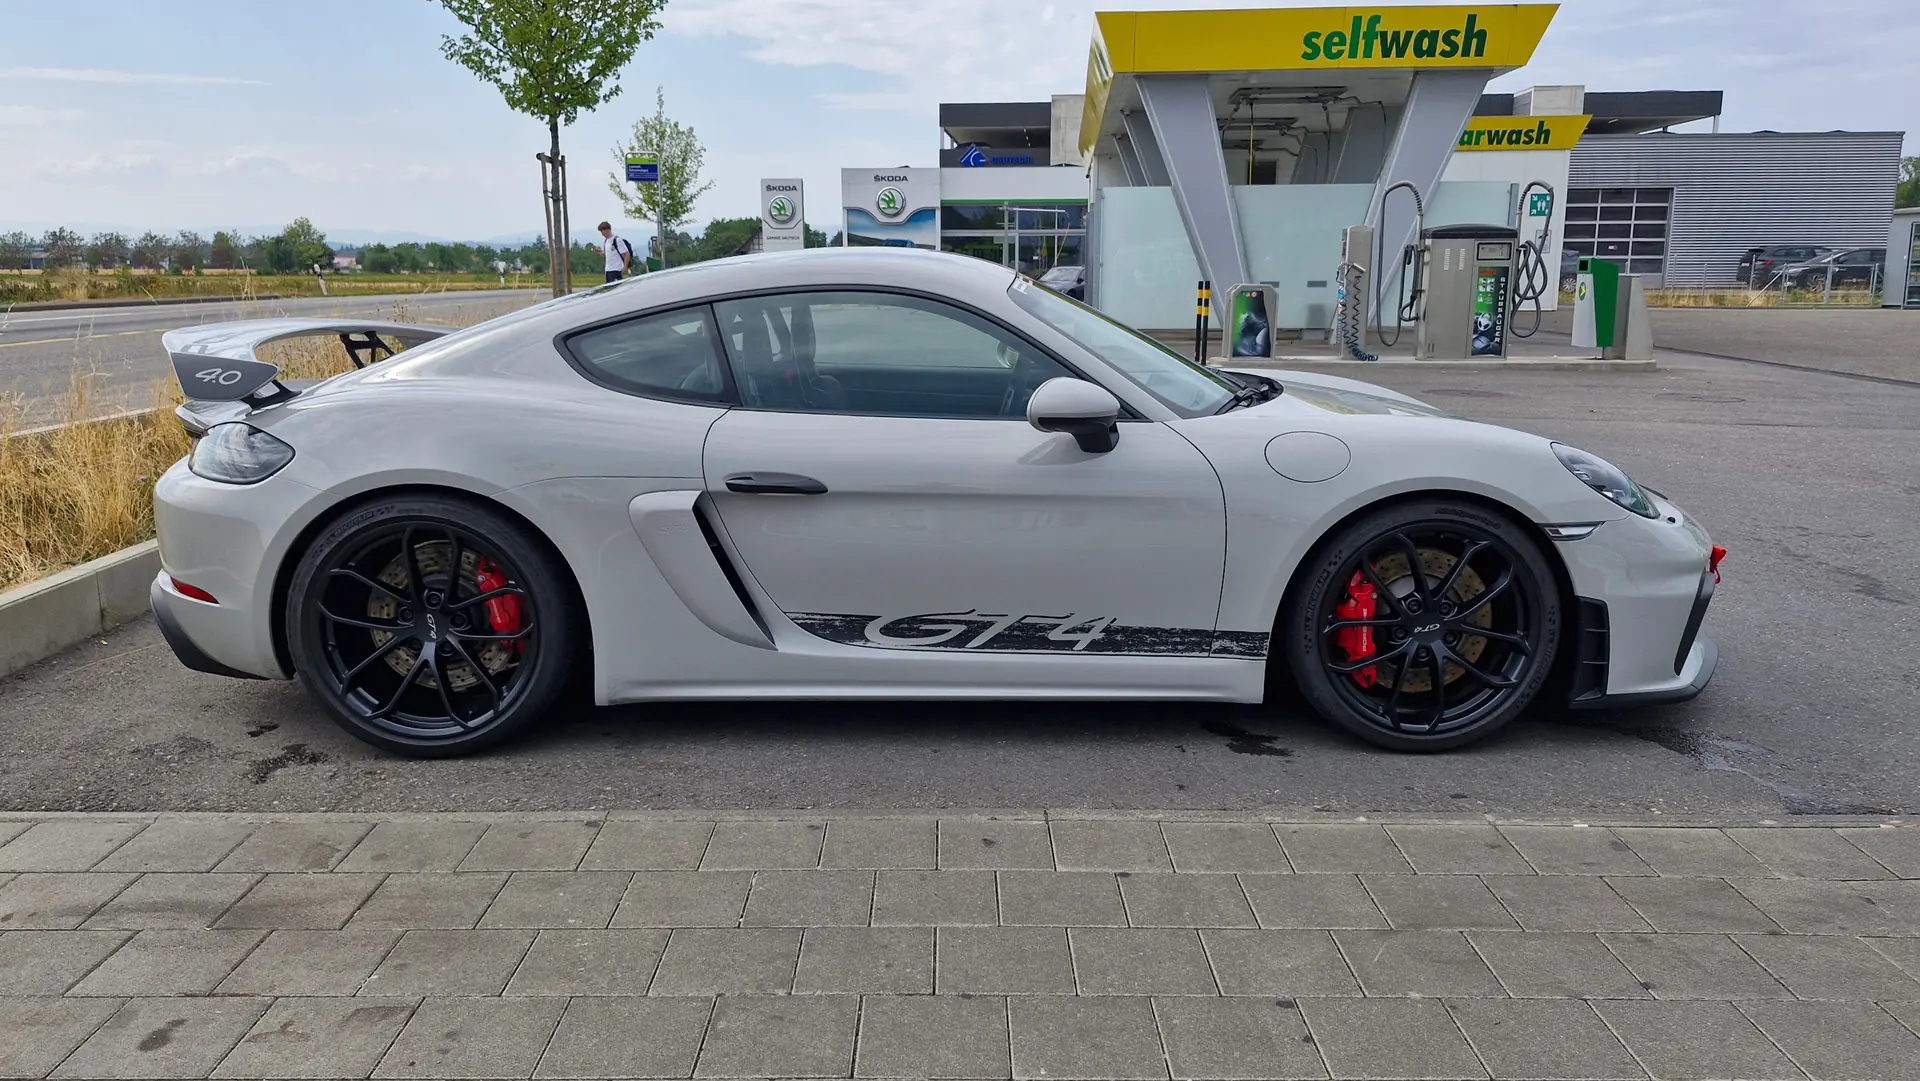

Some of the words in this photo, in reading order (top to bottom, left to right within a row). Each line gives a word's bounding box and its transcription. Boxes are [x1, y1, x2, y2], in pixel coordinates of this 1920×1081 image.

[1301, 13, 1488, 60] selfwash
[1459, 120, 1551, 146] arwash
[766, 184, 797, 192] ŠKODA
[873, 174, 909, 182] ŠKODA
[1494, 276, 1506, 343] STAUBSAUGER
[195, 367, 243, 386] 4.0
[426, 613, 437, 639] GT4
[864, 608, 1118, 651] GT4
[1413, 623, 1440, 633] GT4
